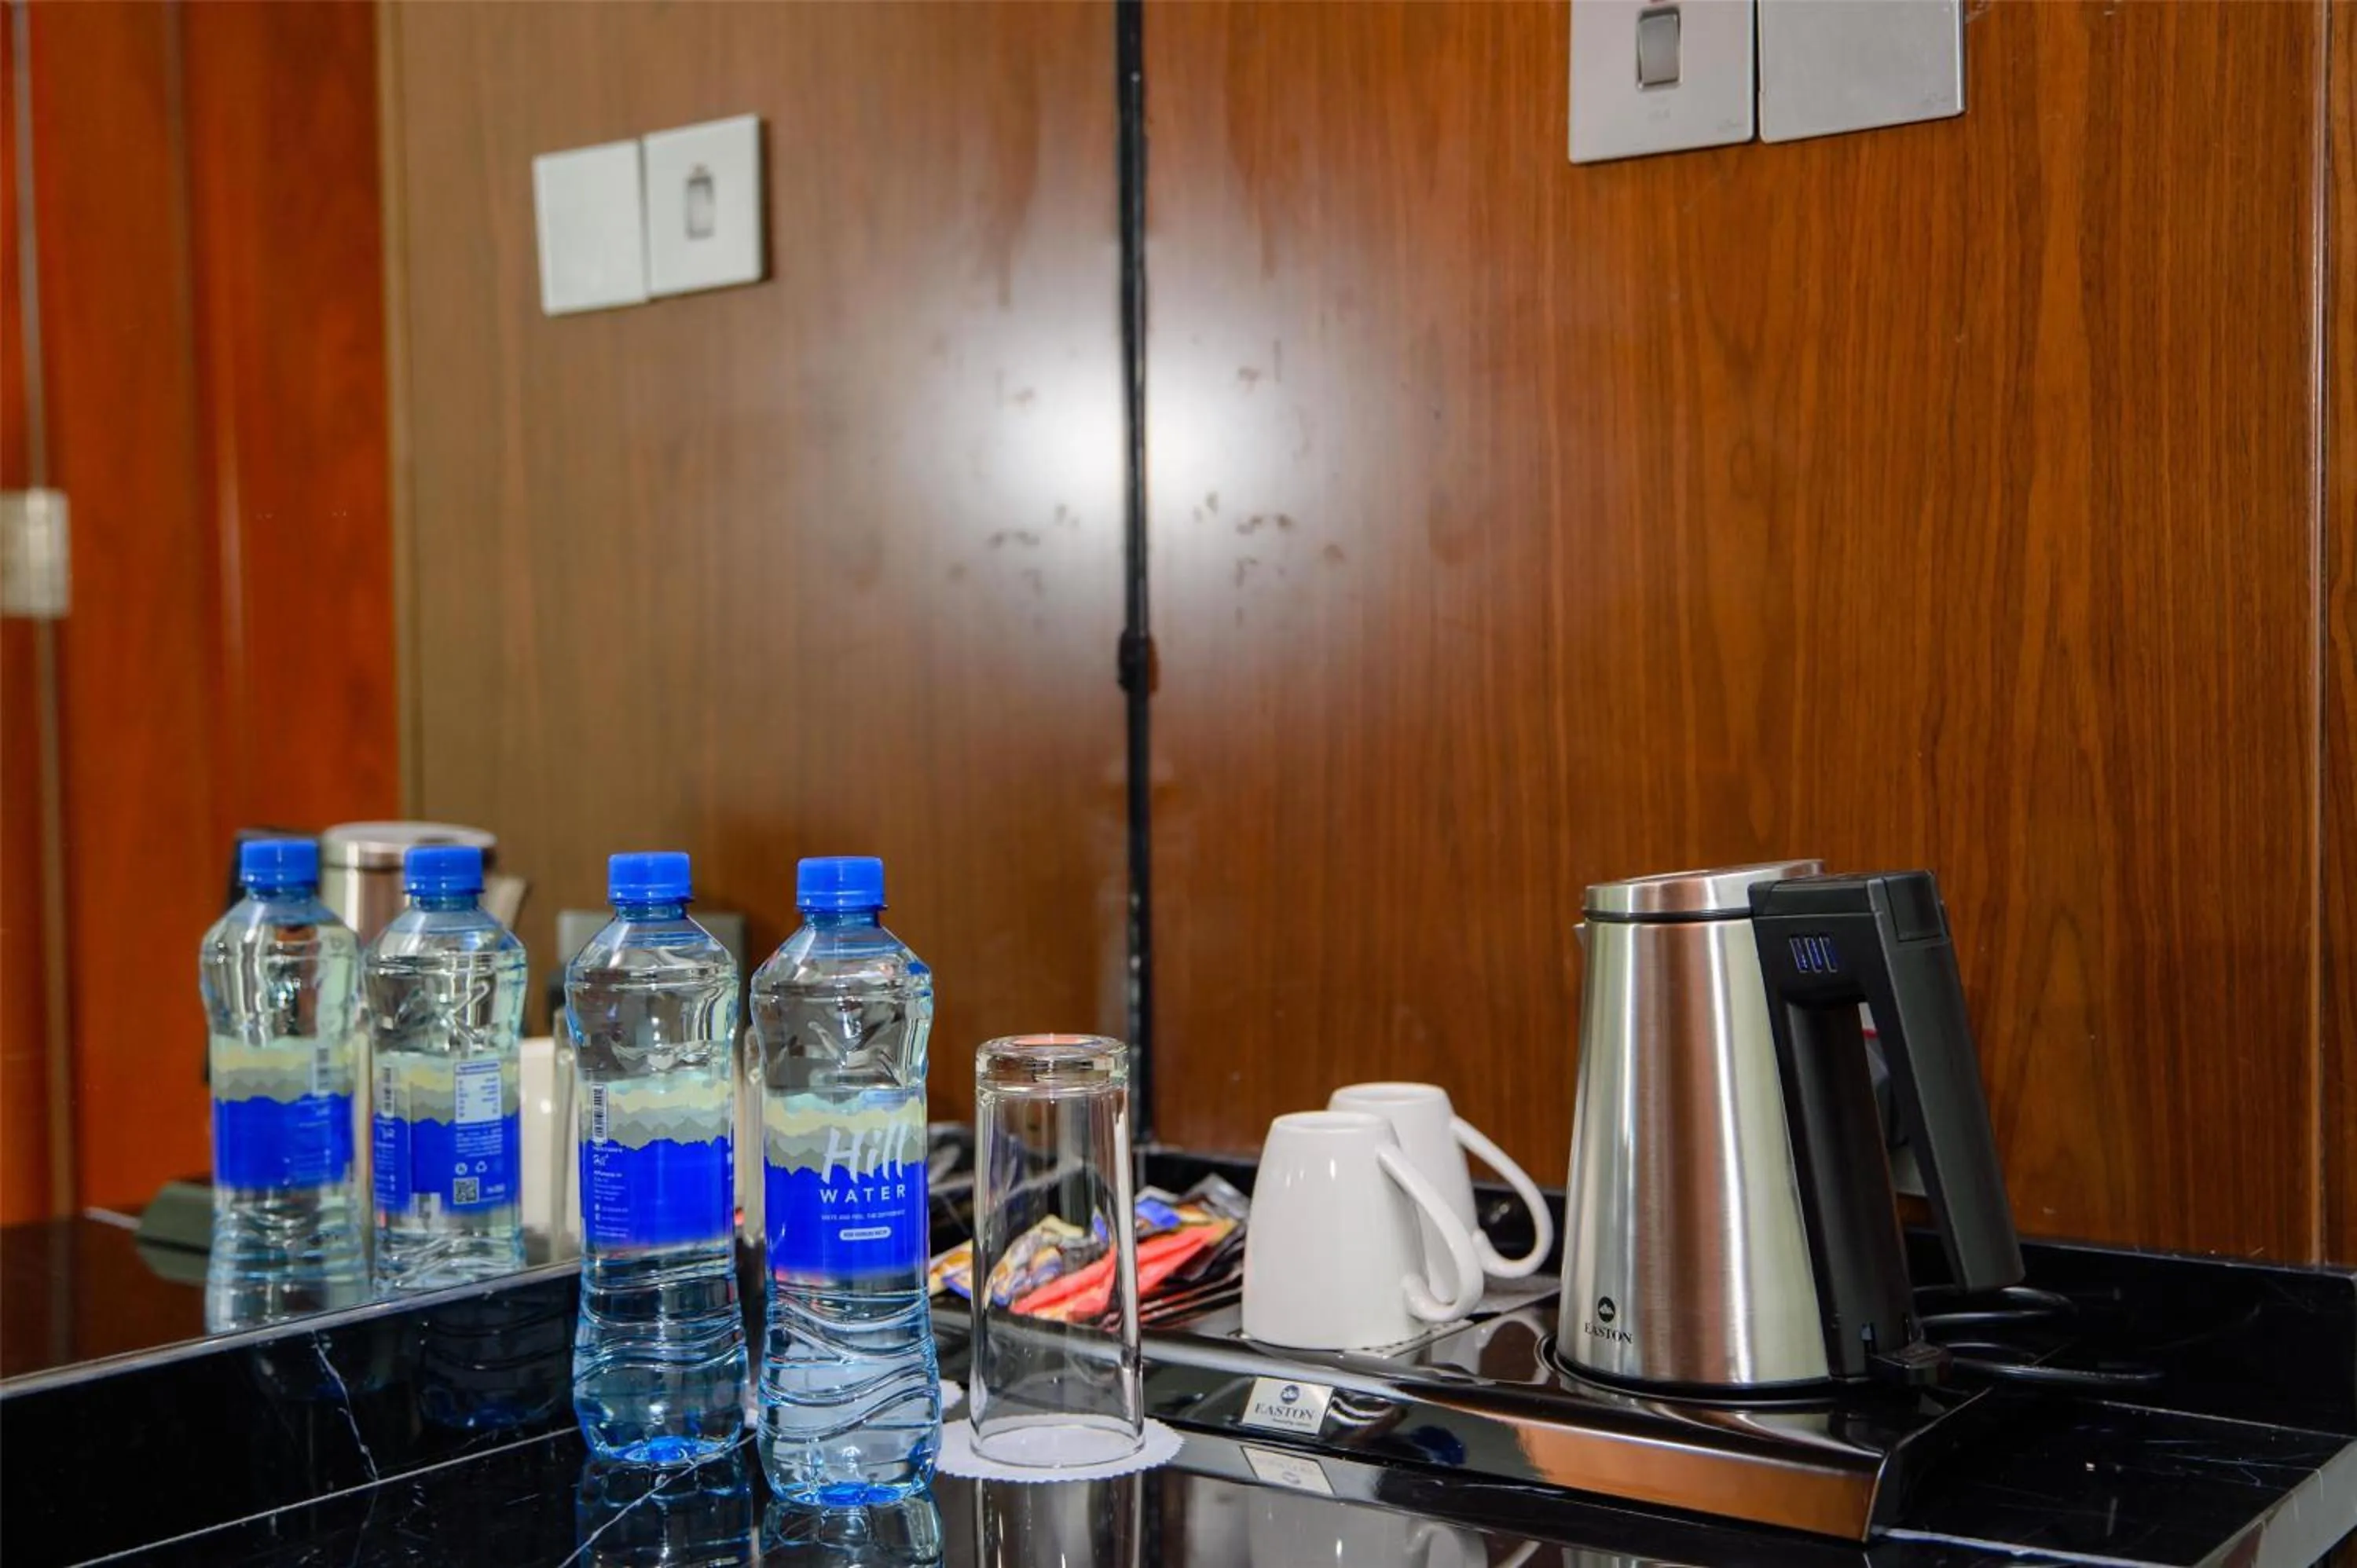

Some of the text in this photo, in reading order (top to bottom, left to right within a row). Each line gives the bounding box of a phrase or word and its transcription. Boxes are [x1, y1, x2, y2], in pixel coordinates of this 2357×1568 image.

[821, 1116, 908, 1184] Hill
[819, 1184, 906, 1203] WATER
[1584, 1322, 1633, 1344] EASTON
[1255, 1402, 1316, 1420] EASTON
